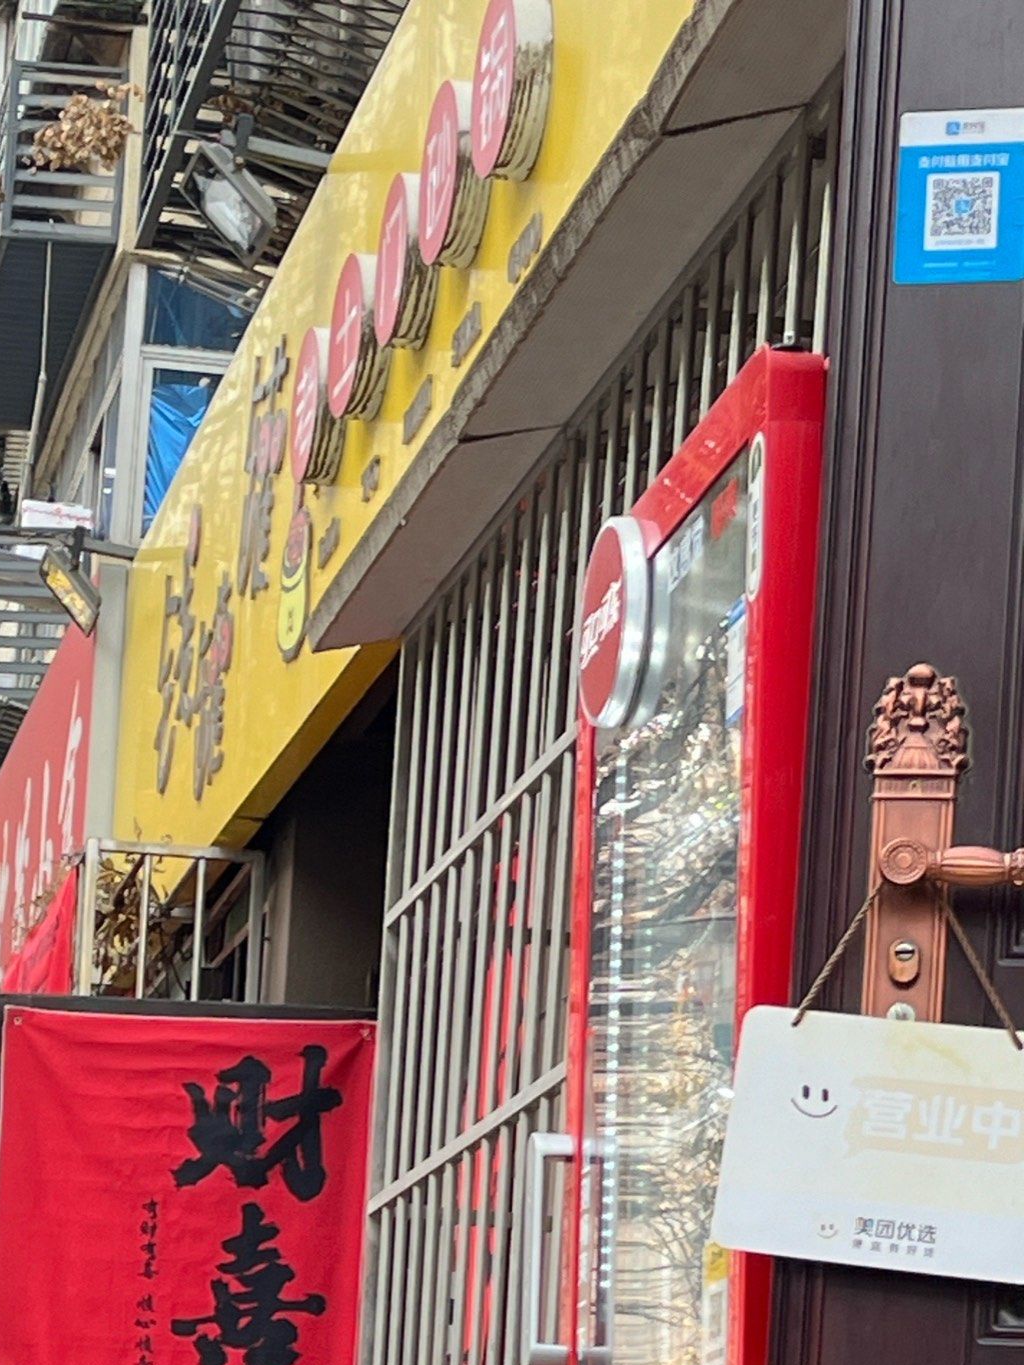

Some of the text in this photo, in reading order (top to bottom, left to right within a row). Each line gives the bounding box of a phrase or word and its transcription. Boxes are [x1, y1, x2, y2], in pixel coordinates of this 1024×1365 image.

[862, 1088, 1021, 1151] 营业中
[853, 1216, 937, 1245] 美团优选
